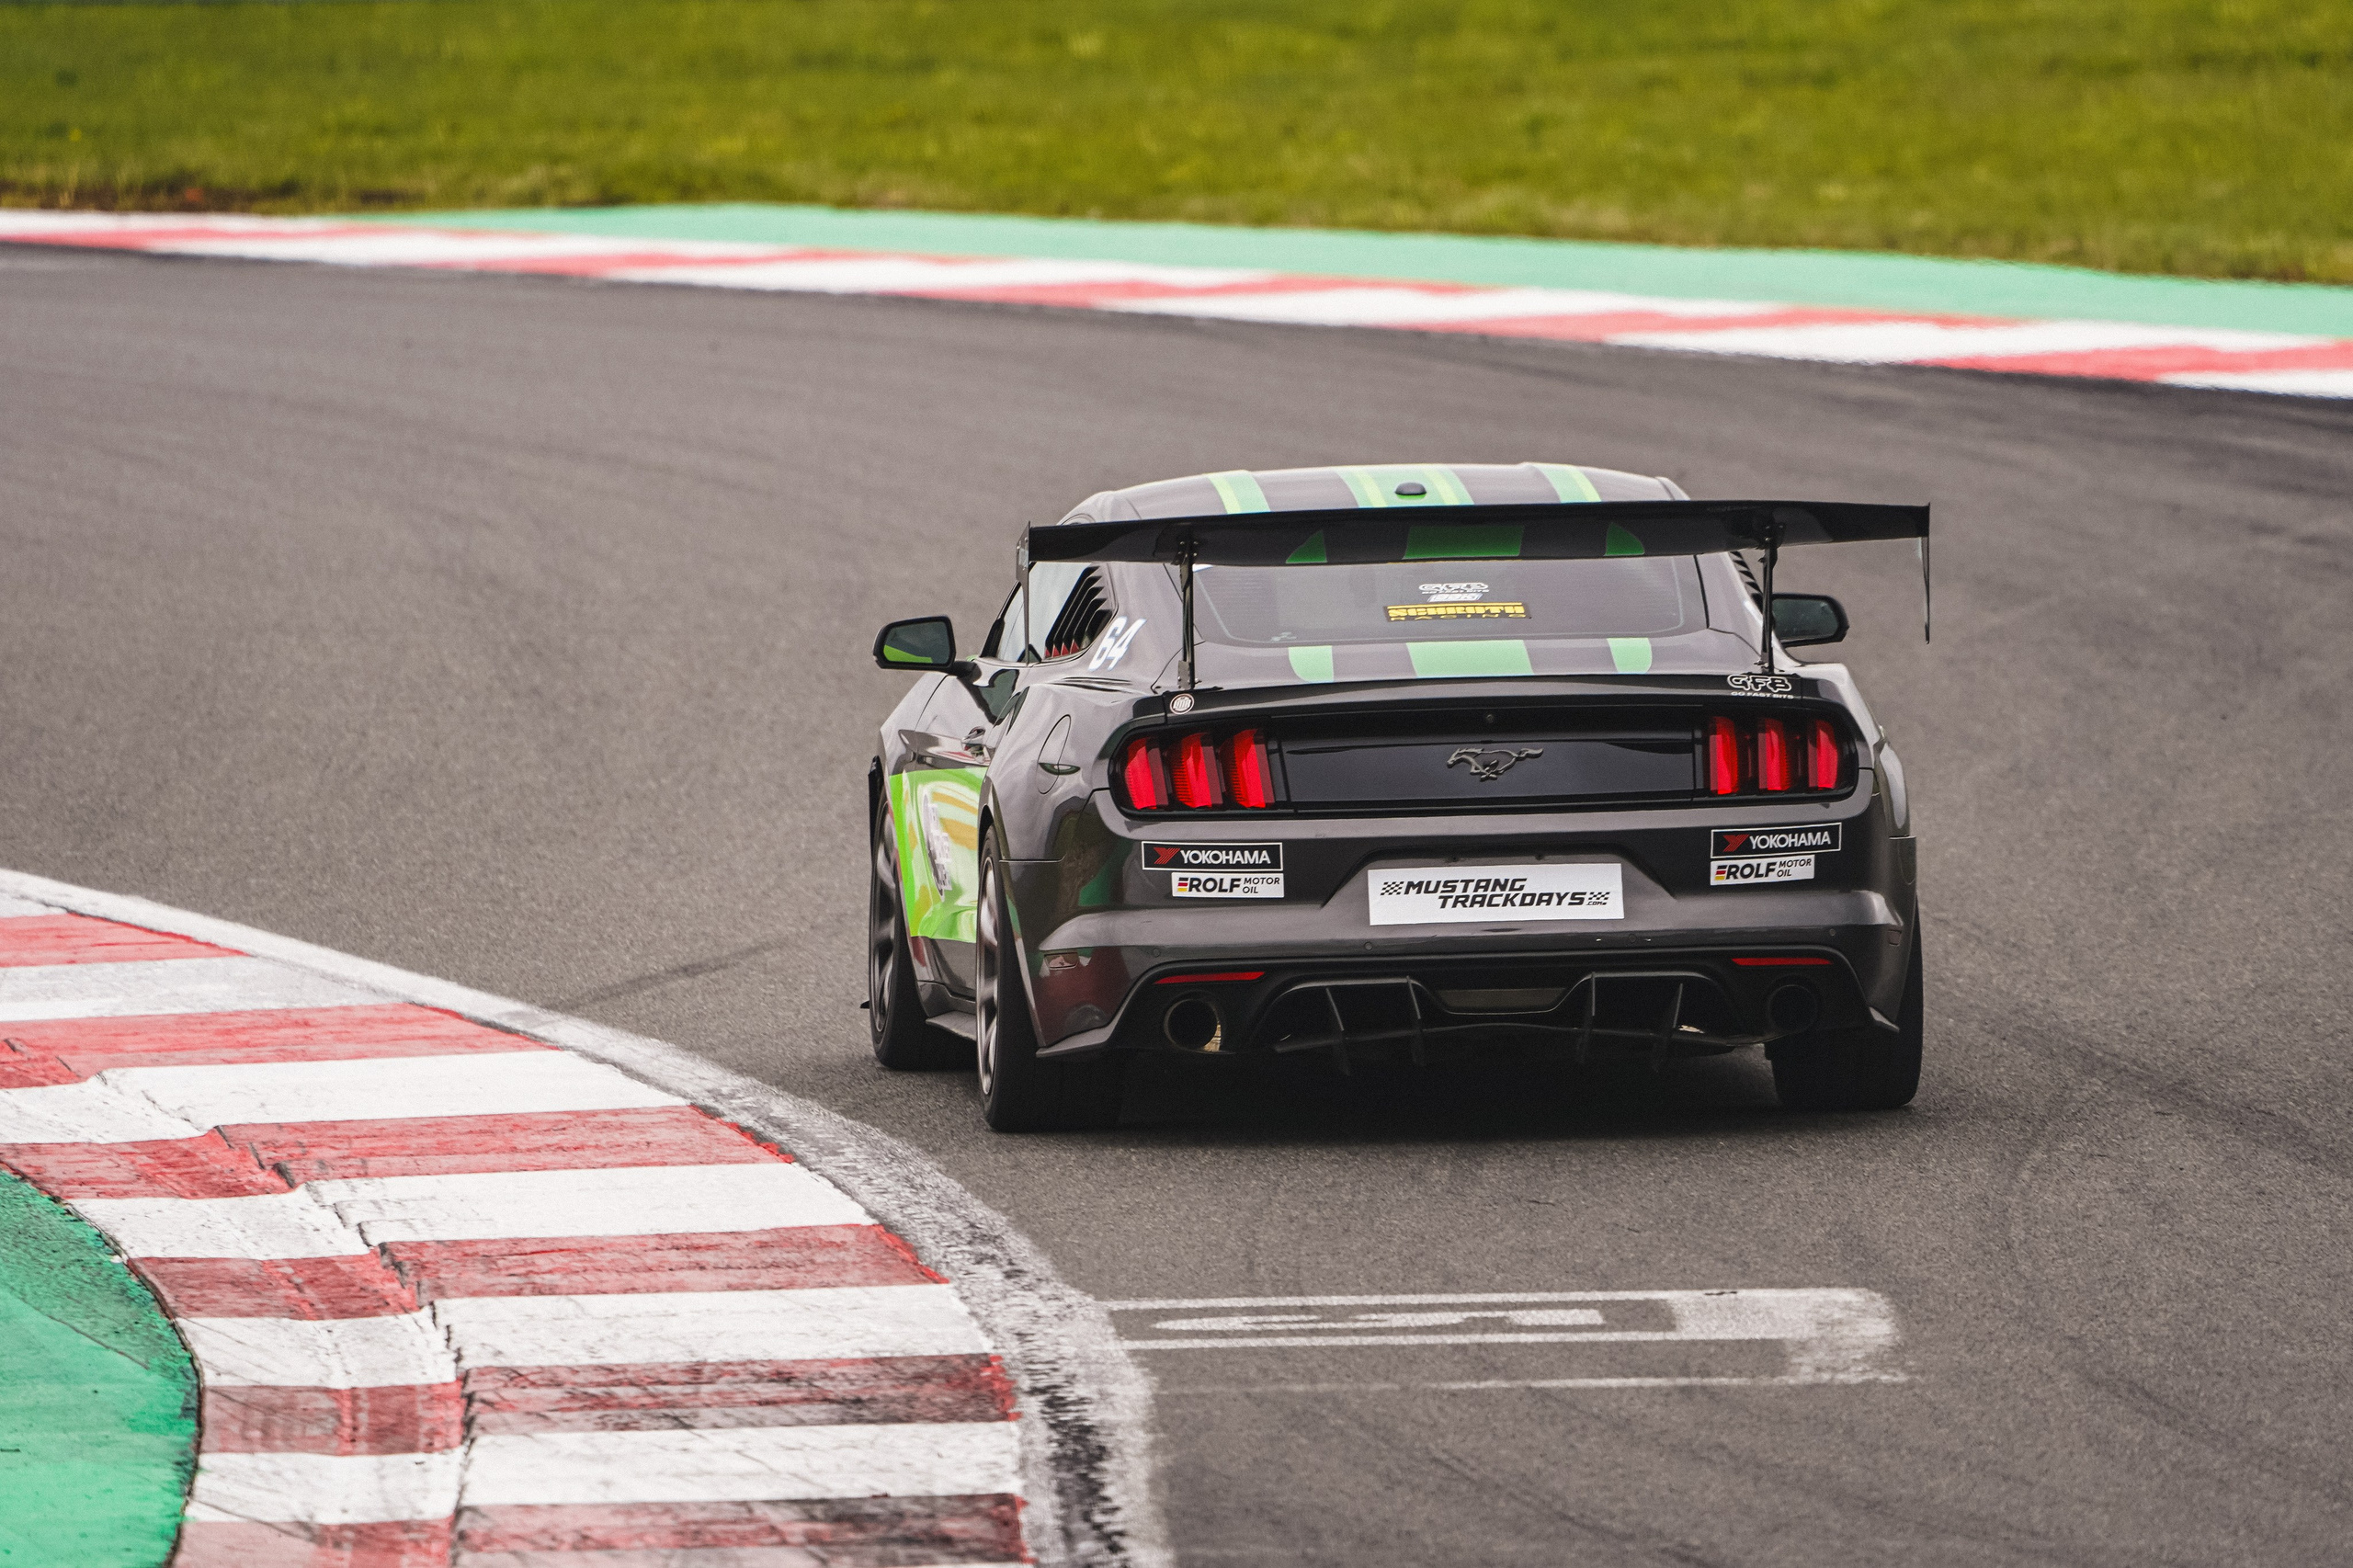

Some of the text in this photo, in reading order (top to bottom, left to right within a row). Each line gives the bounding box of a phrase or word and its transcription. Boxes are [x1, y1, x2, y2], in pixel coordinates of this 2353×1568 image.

[1388, 606, 1526, 618] SCHROTH
[1088, 616, 1147, 672] 64
[1727, 674, 1792, 693] GFB
[1749, 831, 1832, 850] YOKOHAMA
[1180, 850, 1271, 864] YOKOHAMA
[1726, 858, 1813, 880] ROLF MOTOR
[1777, 869, 1792, 878] OIL
[1188, 877, 1280, 892] ROLF MOTOR
[1404, 878, 1528, 895] MUSTANG
[1438, 892, 1587, 909] TRACKDAYS
